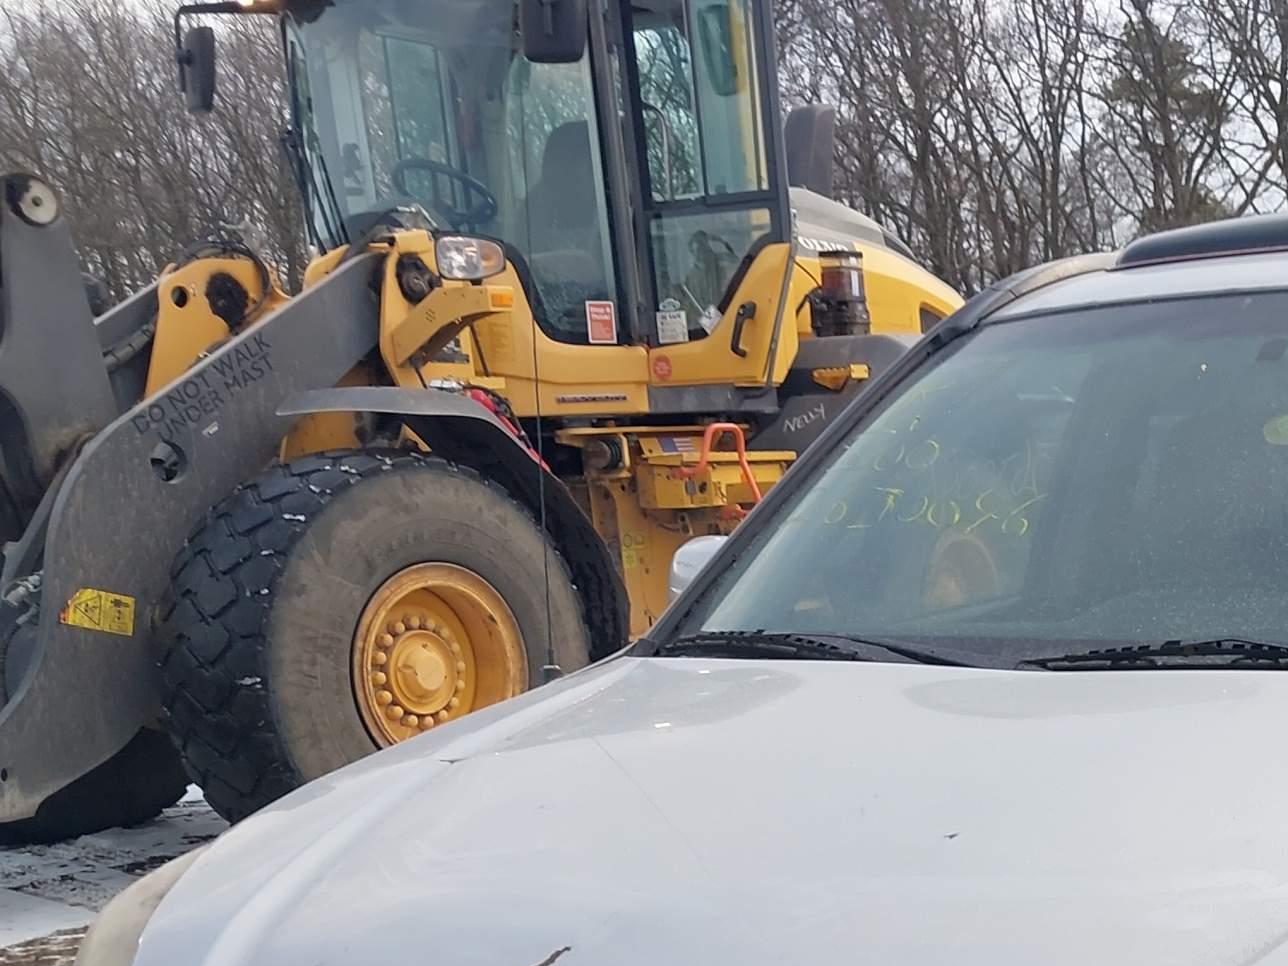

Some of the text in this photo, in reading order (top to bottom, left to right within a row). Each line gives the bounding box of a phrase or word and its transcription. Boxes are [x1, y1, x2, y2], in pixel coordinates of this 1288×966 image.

[131, 331, 273, 435] DO NOT WALK
[158, 352, 273, 442] UNDER MAST
